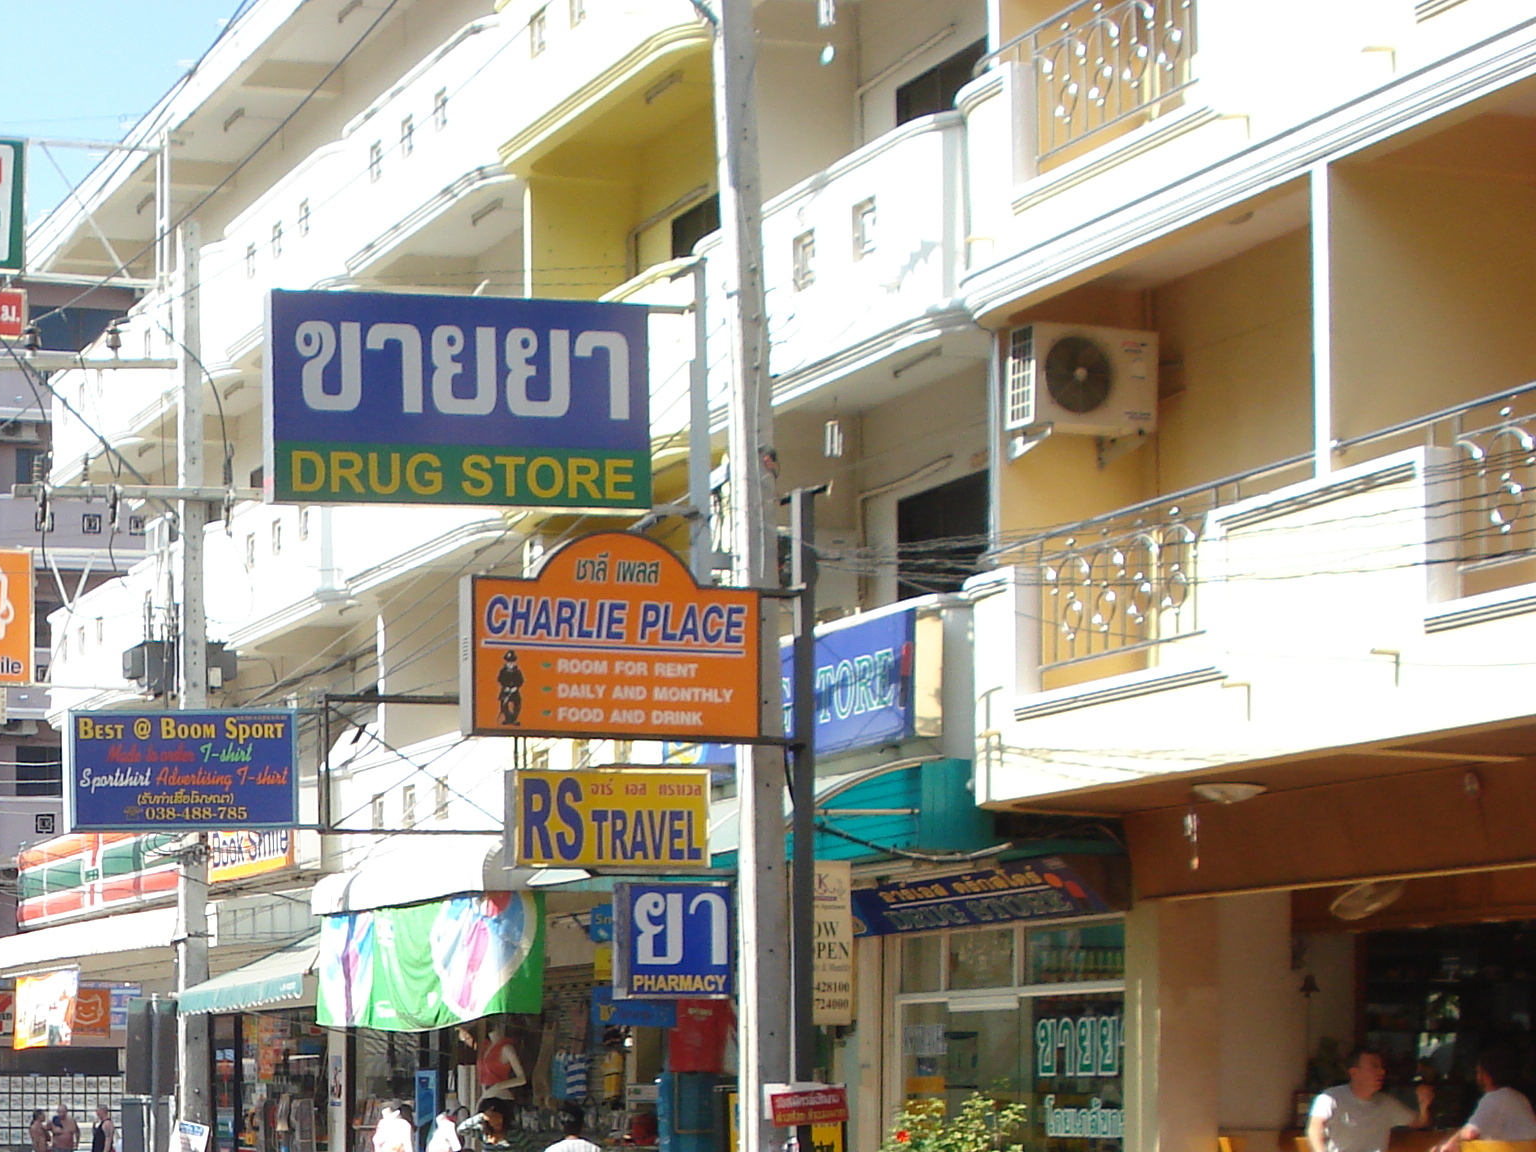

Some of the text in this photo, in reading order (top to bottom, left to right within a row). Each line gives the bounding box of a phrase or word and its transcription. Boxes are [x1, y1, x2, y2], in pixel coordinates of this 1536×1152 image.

[295, 320, 631, 421] ขายยา
[291, 450, 636, 500] DRUG STORE
[575, 552, 661, 585] ชาลี เพลส
[485, 594, 748, 645] CHARLIE PLACE
[556, 658, 699, 678] ROOM FOR RENT
[556, 685, 734, 703] DAILY AND MONTHLY
[815, 648, 895, 723] TORE
[133, 718, 152, 740] @
[161, 717, 216, 739] BOOM
[556, 708, 704, 726] FOOD AND DRINK
[106, 745, 141, 763] Made
[200, 742, 253, 762] T-shirt
[156, 766, 233, 792] Advertising
[236, 766, 288, 786] T-shirt
[625, 782, 647, 796] เอส
[145, 806, 248, 820] 038-488-785
[522, 777, 702, 861] RS TRAVEL
[633, 891, 728, 966] ยา
[882, 903, 970, 931] DRUG
[816, 942, 850, 960] PEN
[633, 974, 727, 992] PHARMACY
